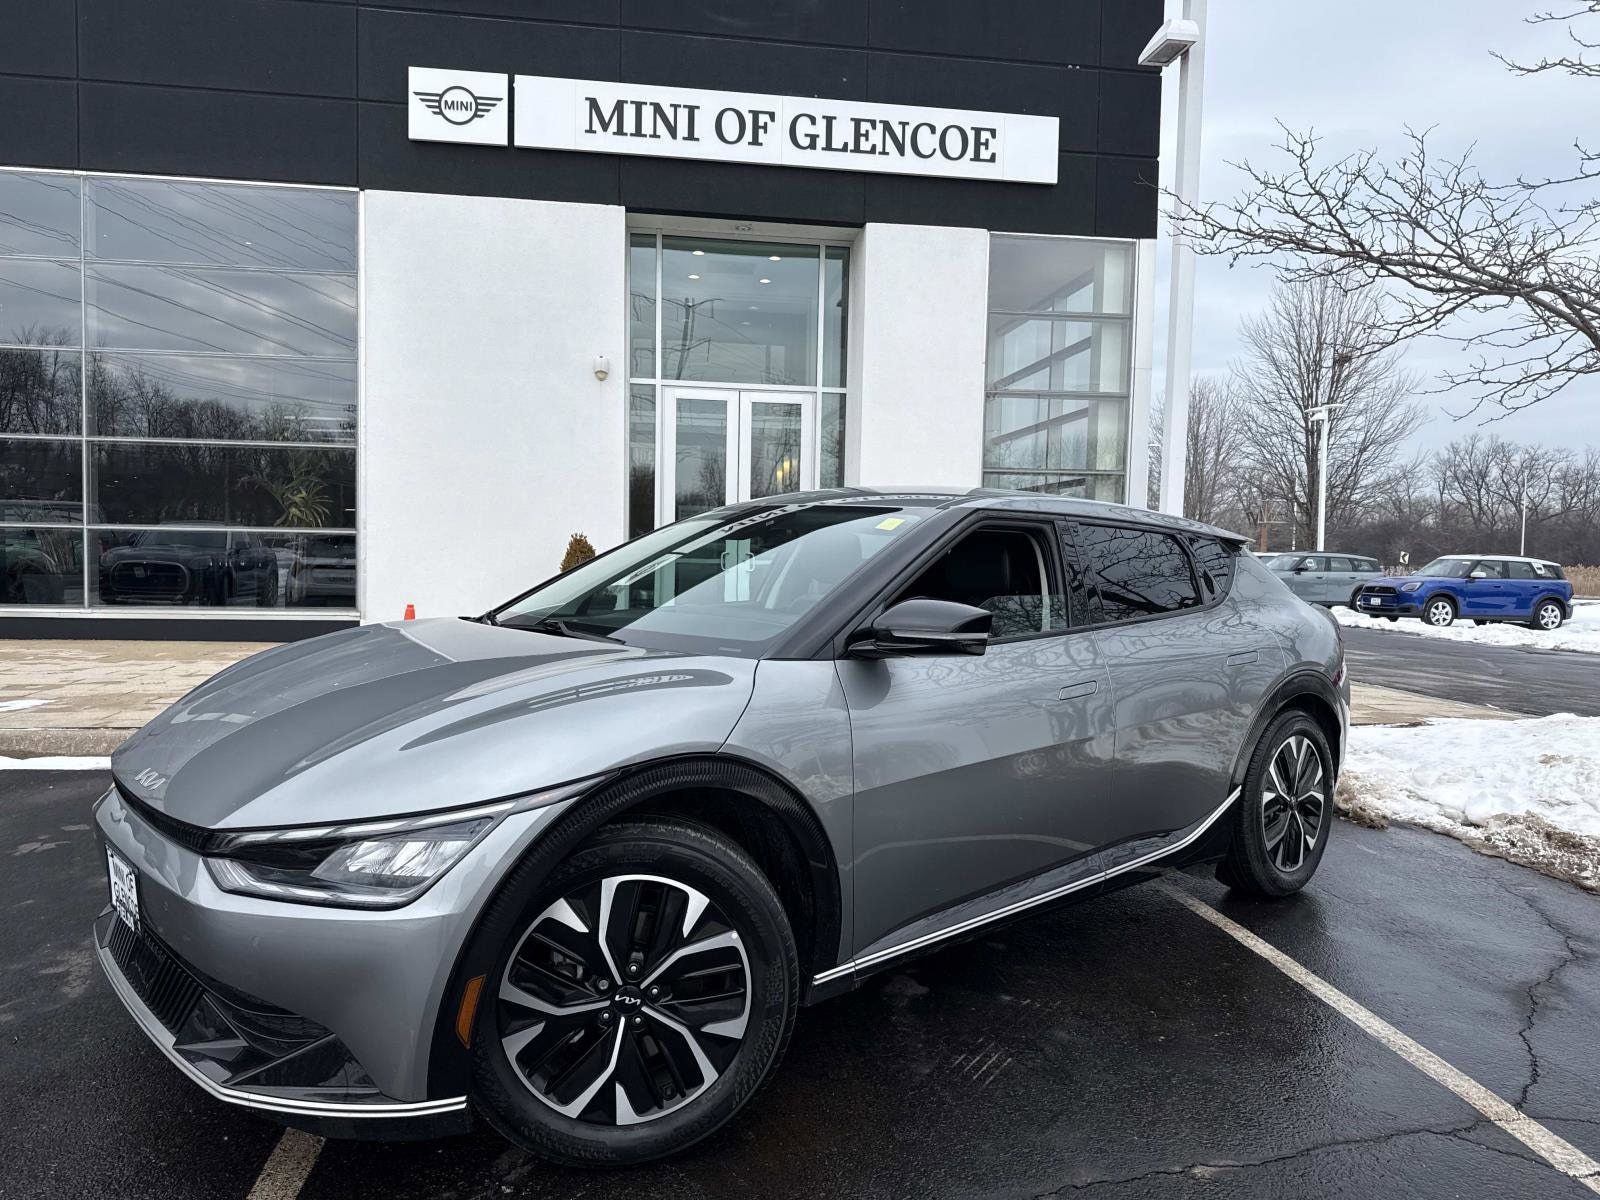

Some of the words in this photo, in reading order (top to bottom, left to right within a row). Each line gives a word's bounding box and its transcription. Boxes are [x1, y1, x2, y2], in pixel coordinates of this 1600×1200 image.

[444, 99, 473, 112] MINI
[584, 96, 701, 142] MINI
[714, 107, 776, 147] OF
[788, 113, 997, 164] GLENCOE
